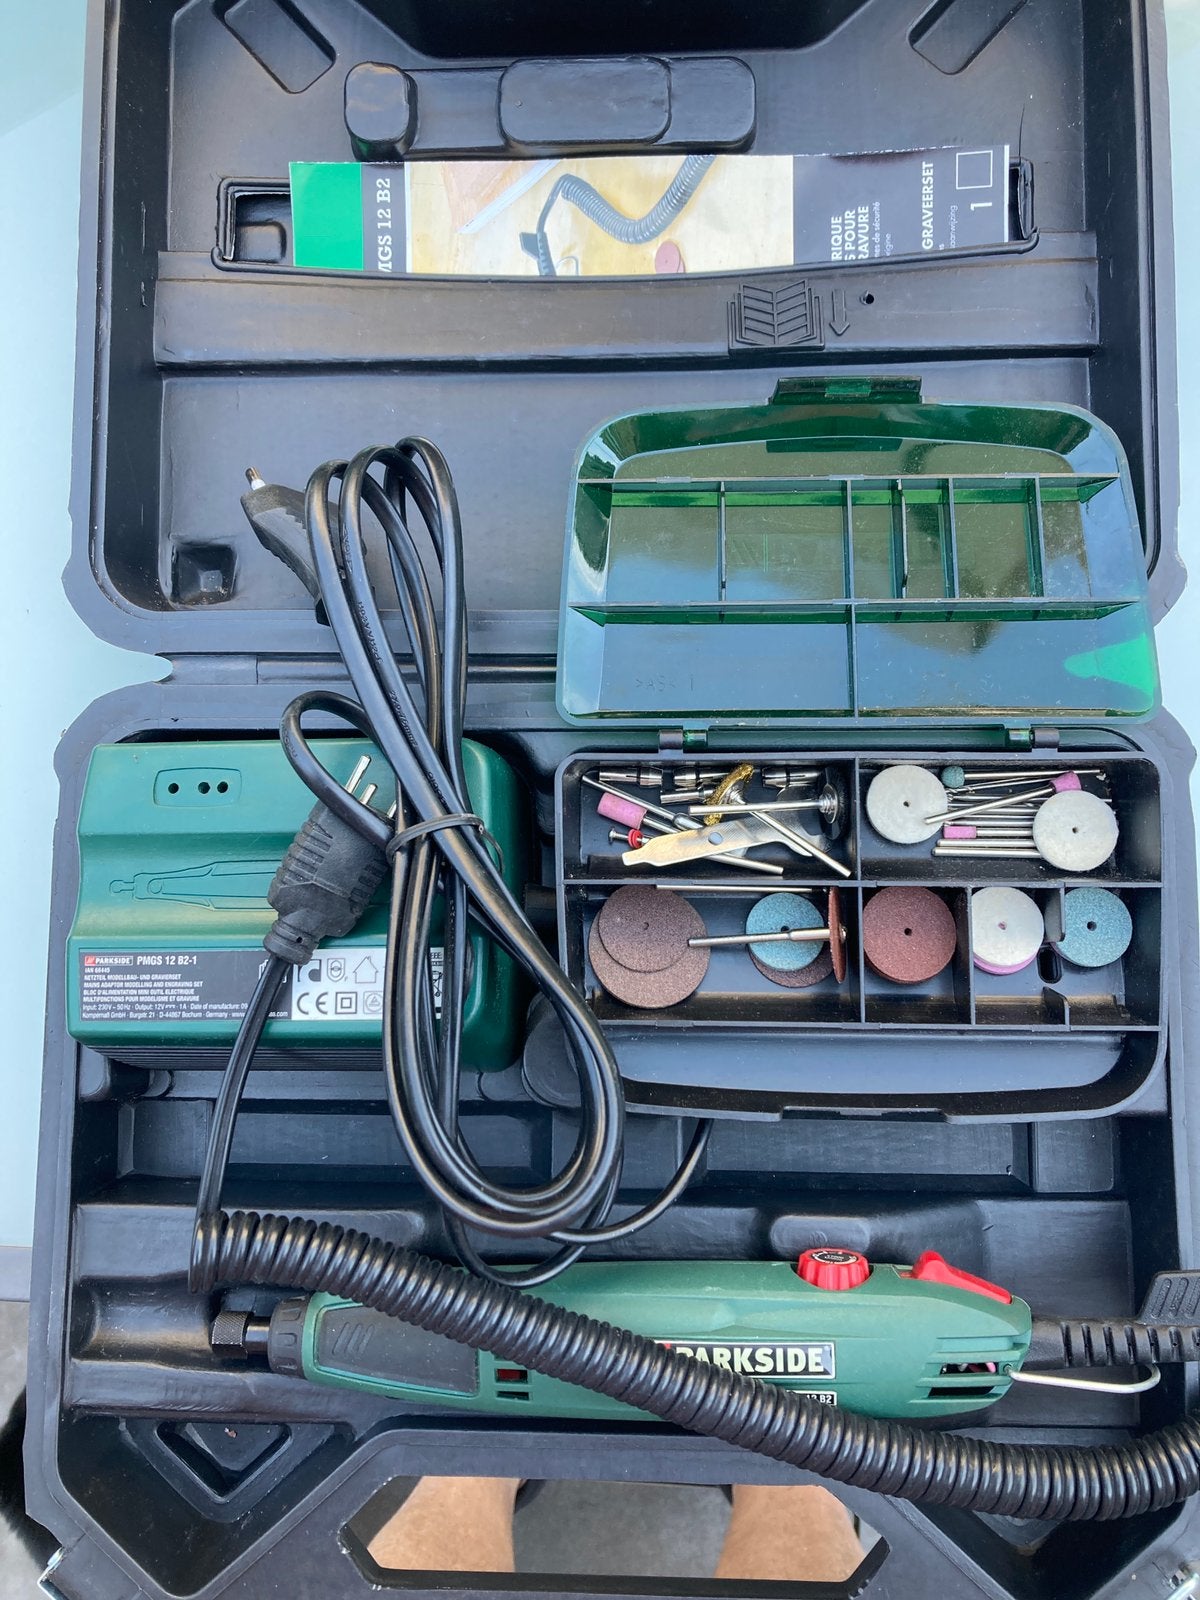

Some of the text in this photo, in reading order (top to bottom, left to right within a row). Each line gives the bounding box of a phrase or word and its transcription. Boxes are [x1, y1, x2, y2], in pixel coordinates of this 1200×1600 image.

[376, 178, 391, 203] B2
[922, 161, 933, 249] GRAVEERSET
[970, 202, 993, 211] 1
[377, 208, 391, 229] 12
[872, 201, 881, 231] sécurité
[844, 209, 856, 251] POUR
[872, 232, 881, 243] de
[137, 956, 162, 965] PMGS
[165, 956, 176, 965] 12
[178, 955, 197, 965] B2-1
[206, 1011, 227, 1019] Germany
[820, 1394, 832, 1404] B2
